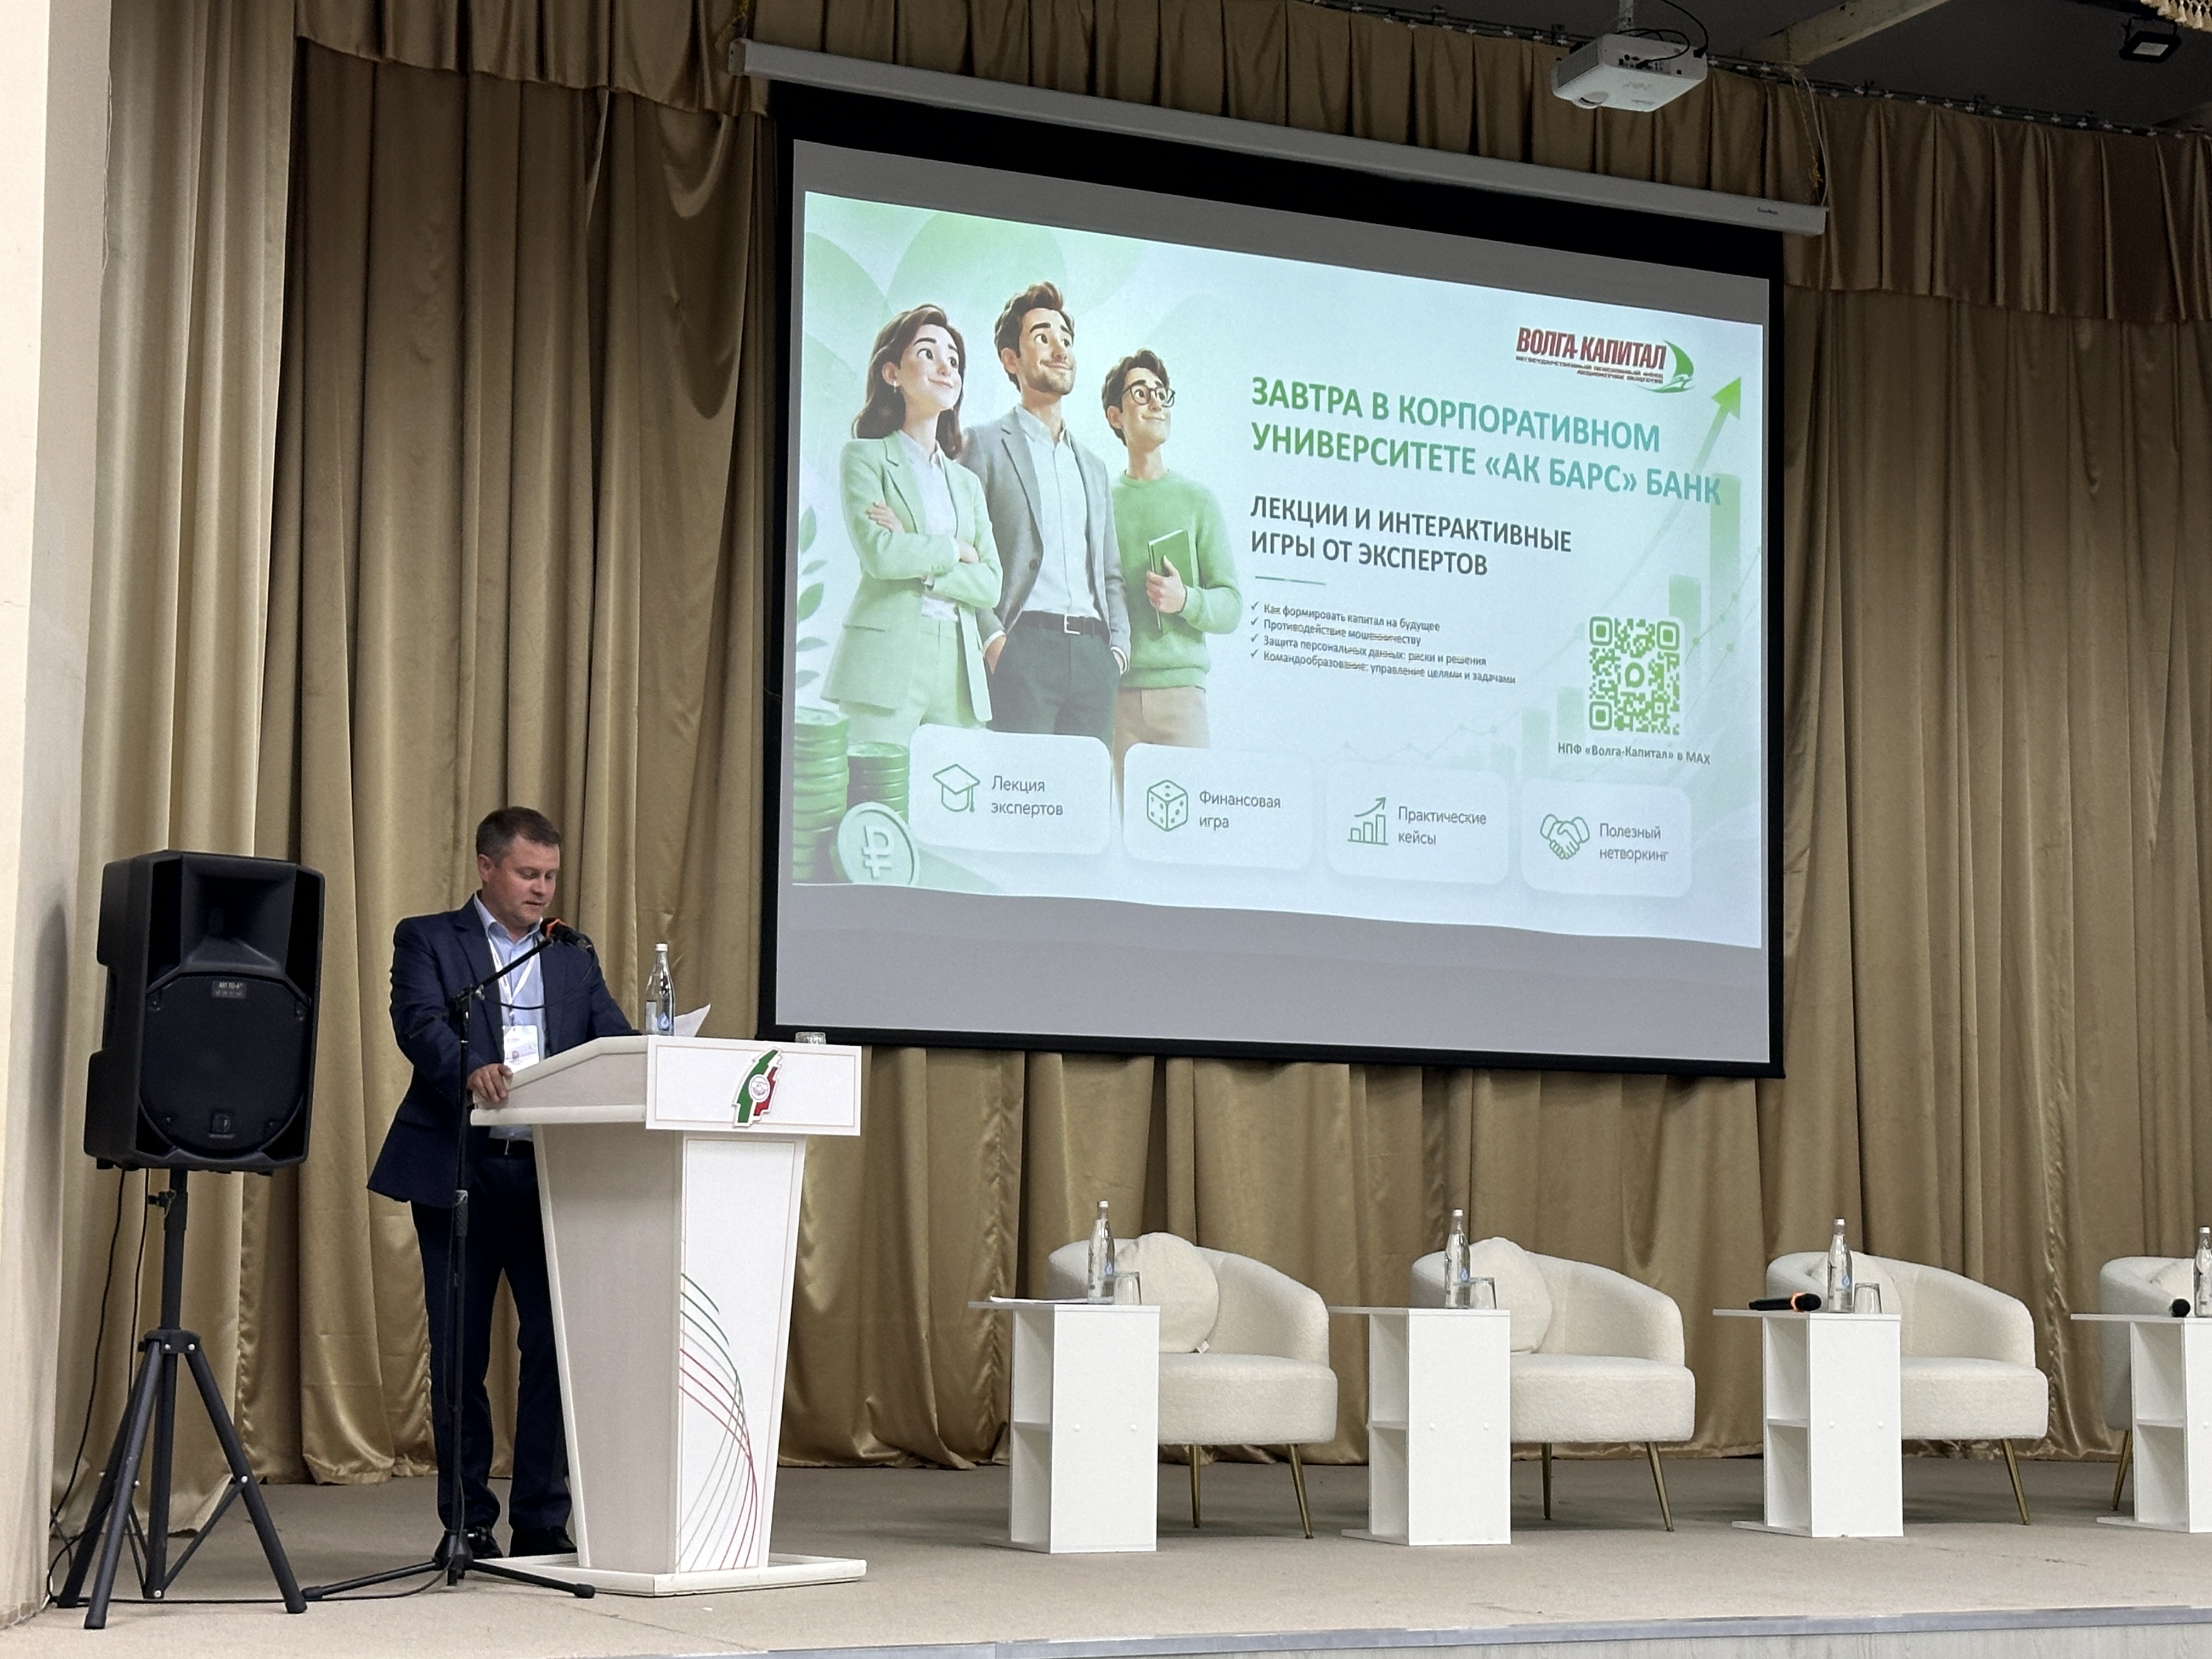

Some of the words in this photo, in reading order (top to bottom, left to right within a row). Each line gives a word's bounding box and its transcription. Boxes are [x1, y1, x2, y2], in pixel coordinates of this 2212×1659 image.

[1251, 376, 1363, 418] ЗАВТРА
[1372, 392, 1389, 420] В
[1399, 394, 1660, 452] КОРПОРАТИВНОМ
[1251, 422, 1476, 475] УНИВЕРСИТЕТЕ
[1485, 453, 1540, 483] «АК
[1549, 458, 1637, 492] БАРС»
[1647, 468, 1721, 505] БАНК
[1250, 495, 1347, 528] ЛЕКЦИИ
[1355, 507, 1370, 529] И
[1379, 510, 1572, 552] ИНТЕРАКТИВНЫЕ
[1251, 531, 1314, 558] ИГРЫ
[1323, 538, 1352, 562] ОТ
[1358, 543, 1488, 575] ЭКСПЕРТОВ
[1264, 603, 1282, 615] Как
[1283, 605, 1346, 622] формировать
[1347, 614, 1384, 627] капитал
[1386, 618, 1397, 627] на
[1400, 618, 1440, 632] будущее
[1264, 619, 1347, 637] Противодействие
[1263, 635, 1299, 649] Защита
[1446, 656, 1487, 666] решения
[1370, 664, 1425, 677] управление
[1427, 669, 1462, 680] целями
[1472, 672, 1516, 684] задачами
[1558, 742, 1582, 755] НПФ
[1585, 744, 1674, 760] «Волга-Капитал»
[991, 775, 1045, 794] Лекция
[1199, 790, 1281, 809] Финансовая
[990, 802, 1064, 819] экспертов
[1398, 806, 1487, 825] Практические
[1199, 815, 1229, 831] игра
[1599, 822, 1661, 840] Полезный
[1398, 830, 1437, 845] кейсы
[1599, 848, 1669, 863] нетворкинг
